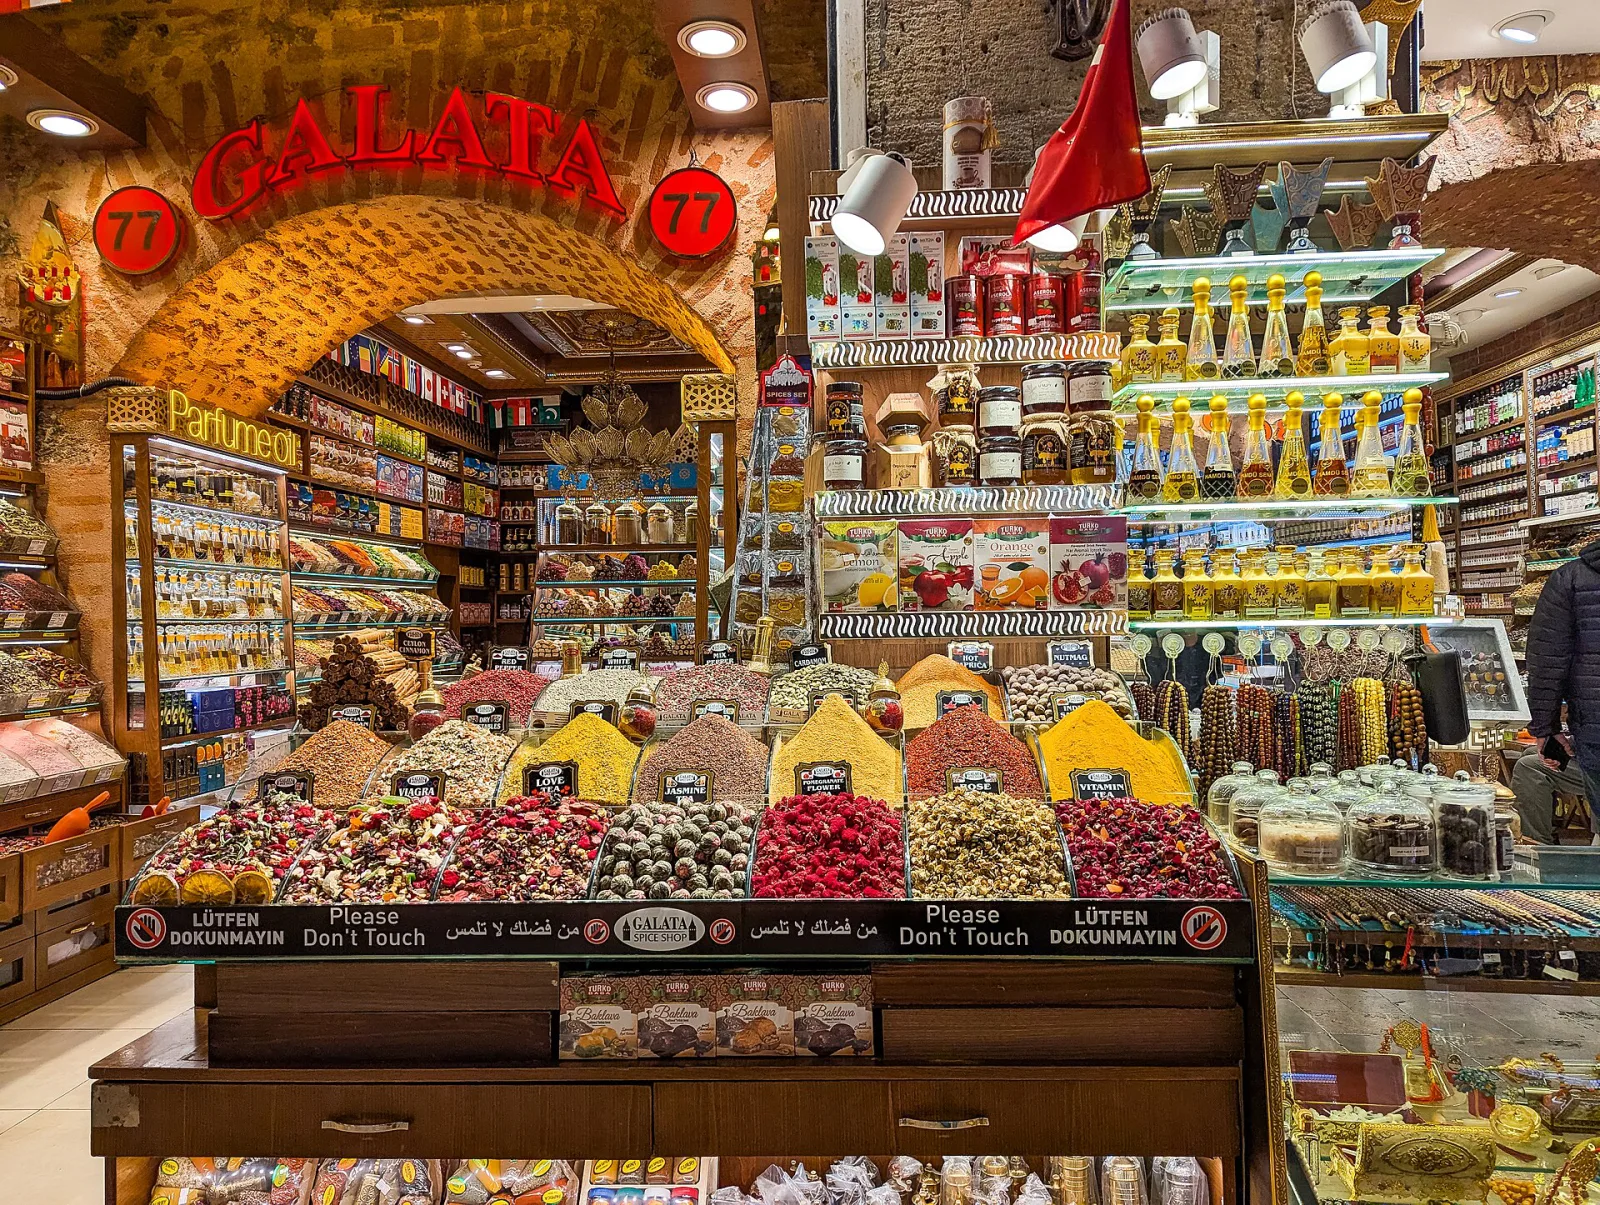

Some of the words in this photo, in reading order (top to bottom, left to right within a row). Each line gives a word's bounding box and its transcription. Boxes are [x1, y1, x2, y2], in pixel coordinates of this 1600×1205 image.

[191, 85, 627, 221] GALATA
[662, 193, 722, 234] 77
[108, 210, 162, 251] 77
[169, 389, 271, 458] Parfume
[1000, 525, 1024, 533] TURKO
[990, 542, 1034, 552] Orange
[399, 646, 430, 655] CINNAMON
[794, 657, 827, 668] CARDAMOM
[958, 661, 988, 669] APRICA
[536, 775, 565, 787] LOVE
[802, 778, 844, 786] POMEGRANATE
[959, 783, 992, 791] ROSE
[1079, 783, 1125, 791] VITAMIN
[398, 786, 435, 798] VIAGRA
[540, 785, 561, 793] TEA
[664, 786, 706, 795] JASMINE
[1091, 790, 1114, 798] TEA
[192, 909, 259, 927] LÜTFEN
[329, 907, 399, 925] Please
[926, 904, 1000, 923] Please
[1074, 906, 1148, 926] LÜTFEN
[446, 921, 488, 939] تلمس
[492, 920, 504, 937] لا
[509, 919, 552, 936] فضلك
[632, 916, 688, 930] GALATA
[750, 920, 790, 939] تلمس
[794, 919, 804, 936] لا
[810, 917, 852, 936] فضلك
[856, 921, 878, 939] من
[170, 930, 285, 946] DOKUNMAYIN
[303, 929, 358, 946] Don't
[364, 928, 426, 946] Touch
[557, 923, 580, 939] من
[633, 933, 659, 942] SPICE
[660, 933, 688, 942] SHOP
[900, 927, 957, 946] Don't
[962, 926, 1029, 946] Touch
[1050, 929, 1177, 946] DOKUNMAYIN
[588, 984, 612, 992] TURKO
[666, 982, 690, 990] TURKO
[821, 981, 845, 989] TURKO
[575, 1007, 621, 1021] Baklava
[654, 1004, 699, 1019] Baklava
[732, 1003, 777, 1017] Baklava
[810, 1004, 856, 1018] Baklava
